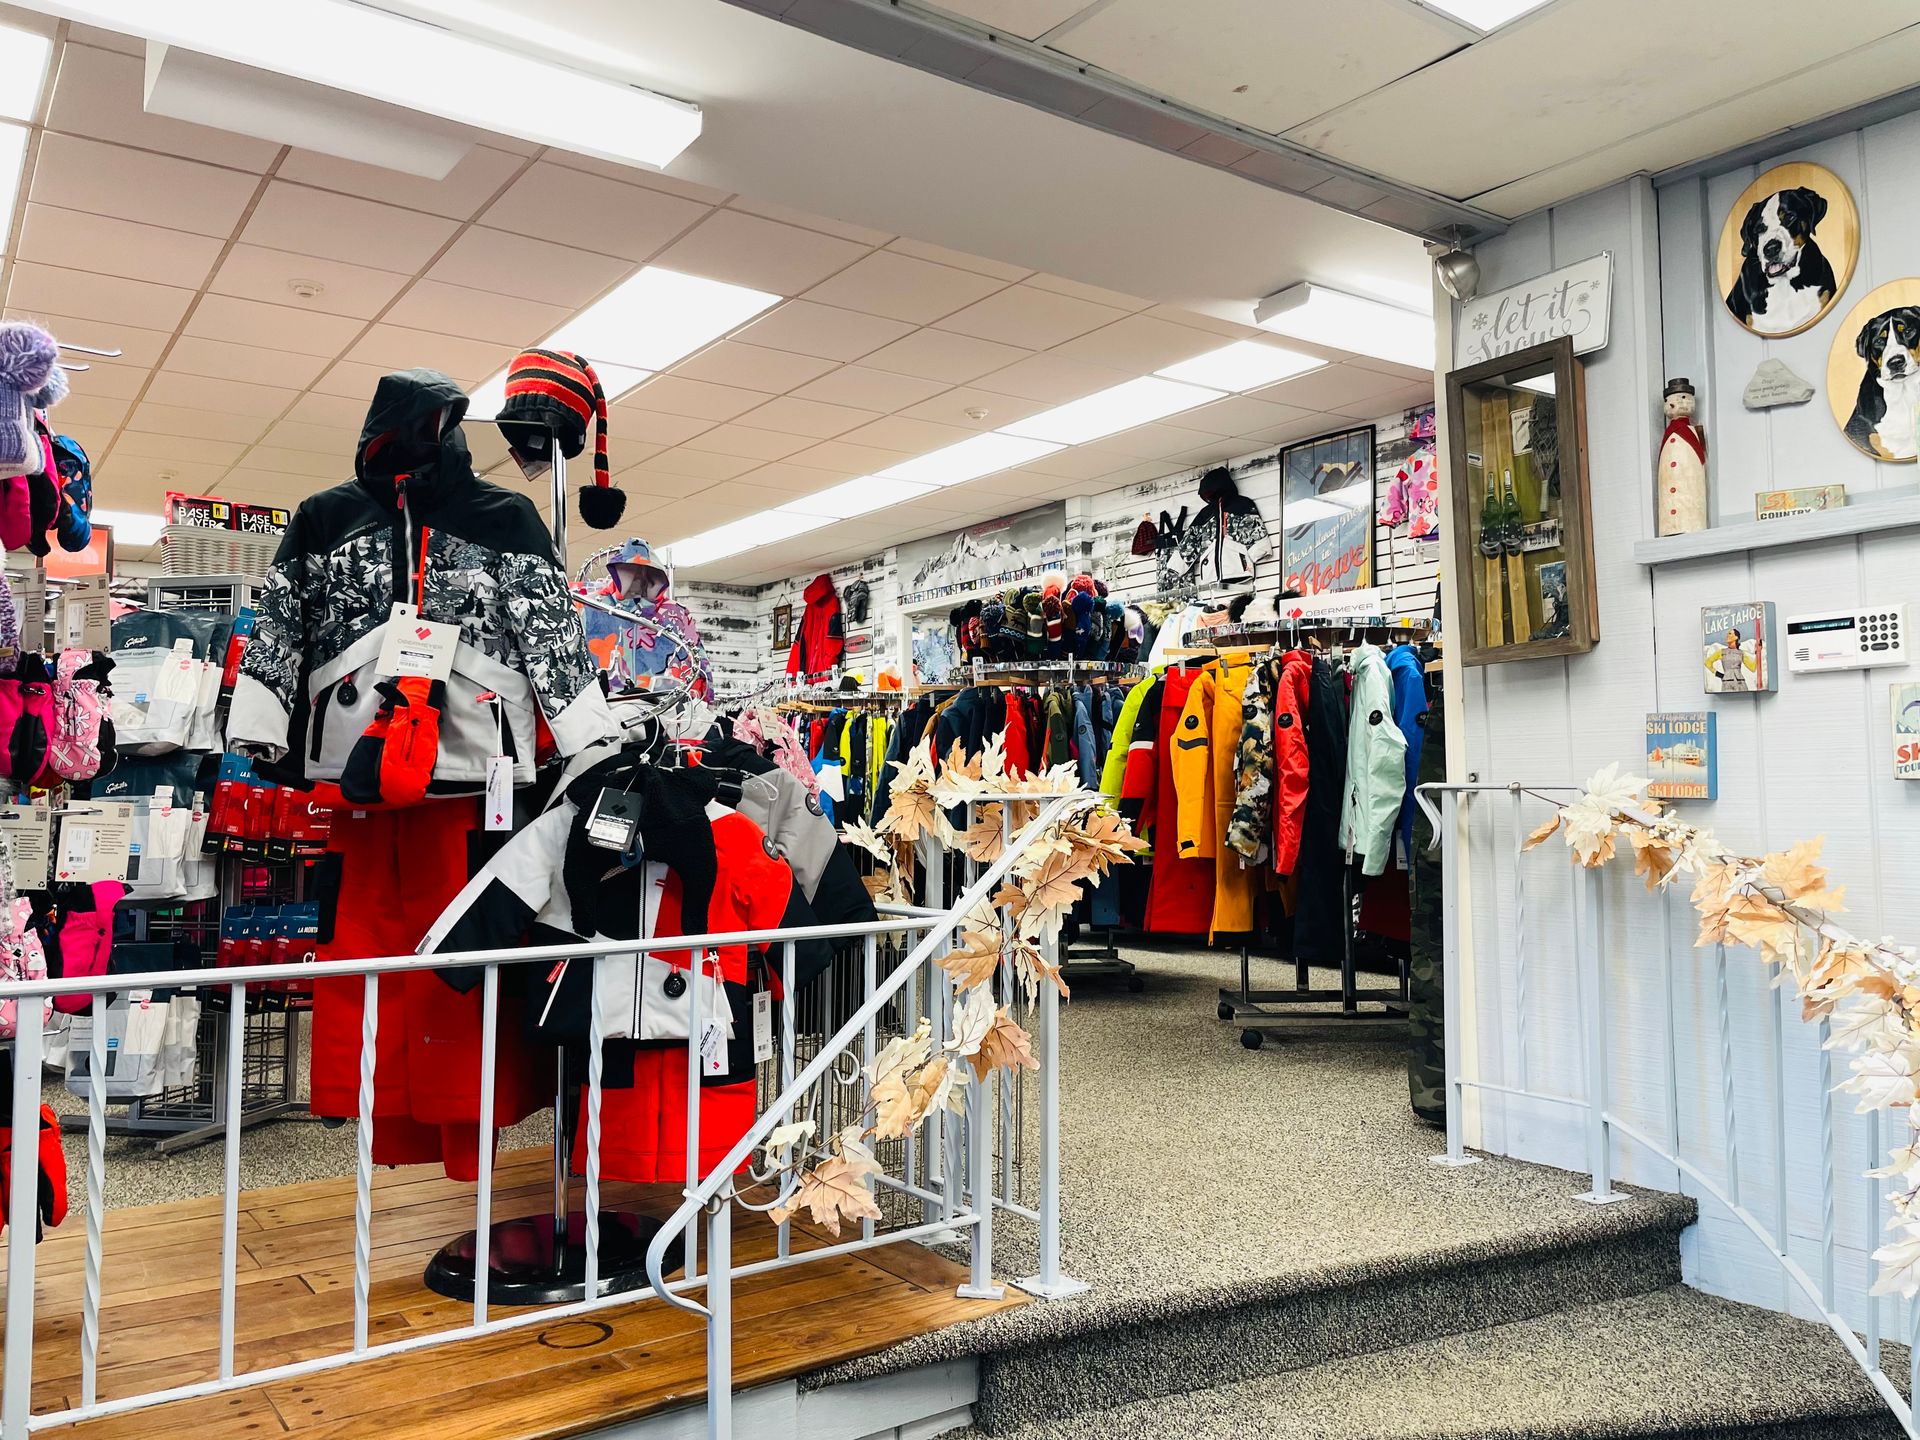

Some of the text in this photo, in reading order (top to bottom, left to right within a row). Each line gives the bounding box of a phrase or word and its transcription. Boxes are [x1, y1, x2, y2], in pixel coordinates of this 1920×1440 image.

[1489, 280, 1588, 340] let it
[178, 507, 210, 520] BASE
[240, 513, 271, 526] BASE
[241, 522, 277, 535] LAYER
[1286, 543, 1368, 597] Stowe
[1305, 602, 1374, 617] OBERMEYER
[1704, 616, 1729, 635] LAKE
[1730, 604, 1762, 627] TAHOE
[1647, 720, 1707, 734] SKI LODGE
[1896, 743, 1920, 764] SK
[1896, 762, 1920, 774] TOU
[1648, 784, 1708, 797] SKI LODGE
